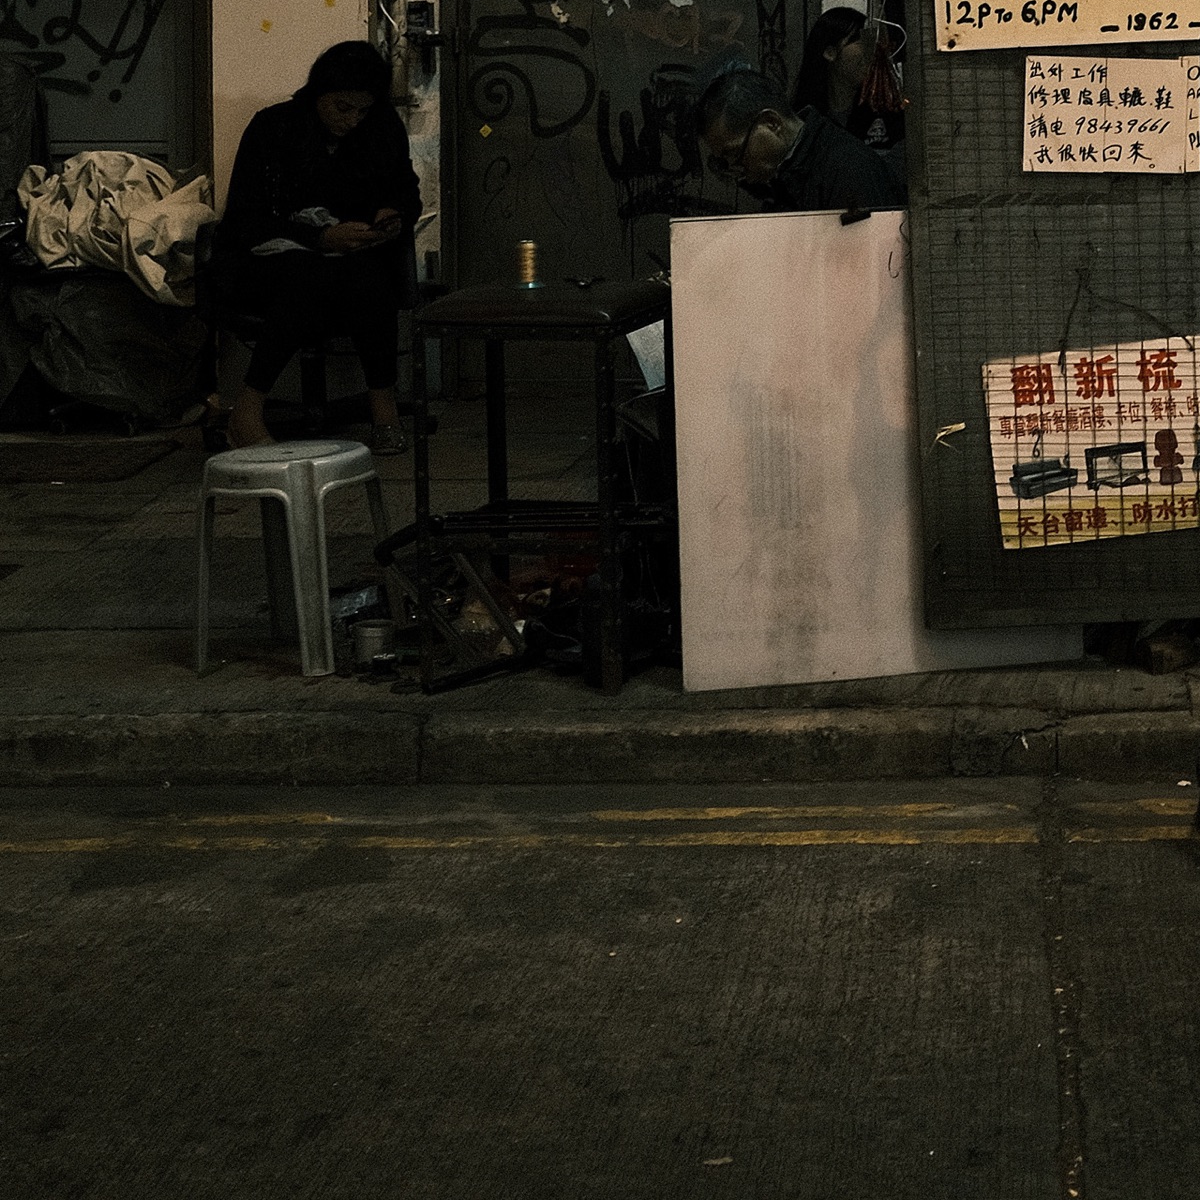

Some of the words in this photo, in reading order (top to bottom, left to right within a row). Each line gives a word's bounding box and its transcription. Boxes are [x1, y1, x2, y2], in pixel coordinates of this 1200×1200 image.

[1029, 61, 1108, 83] 出外工作
[1075, 116, 1171, 136] 98439661
